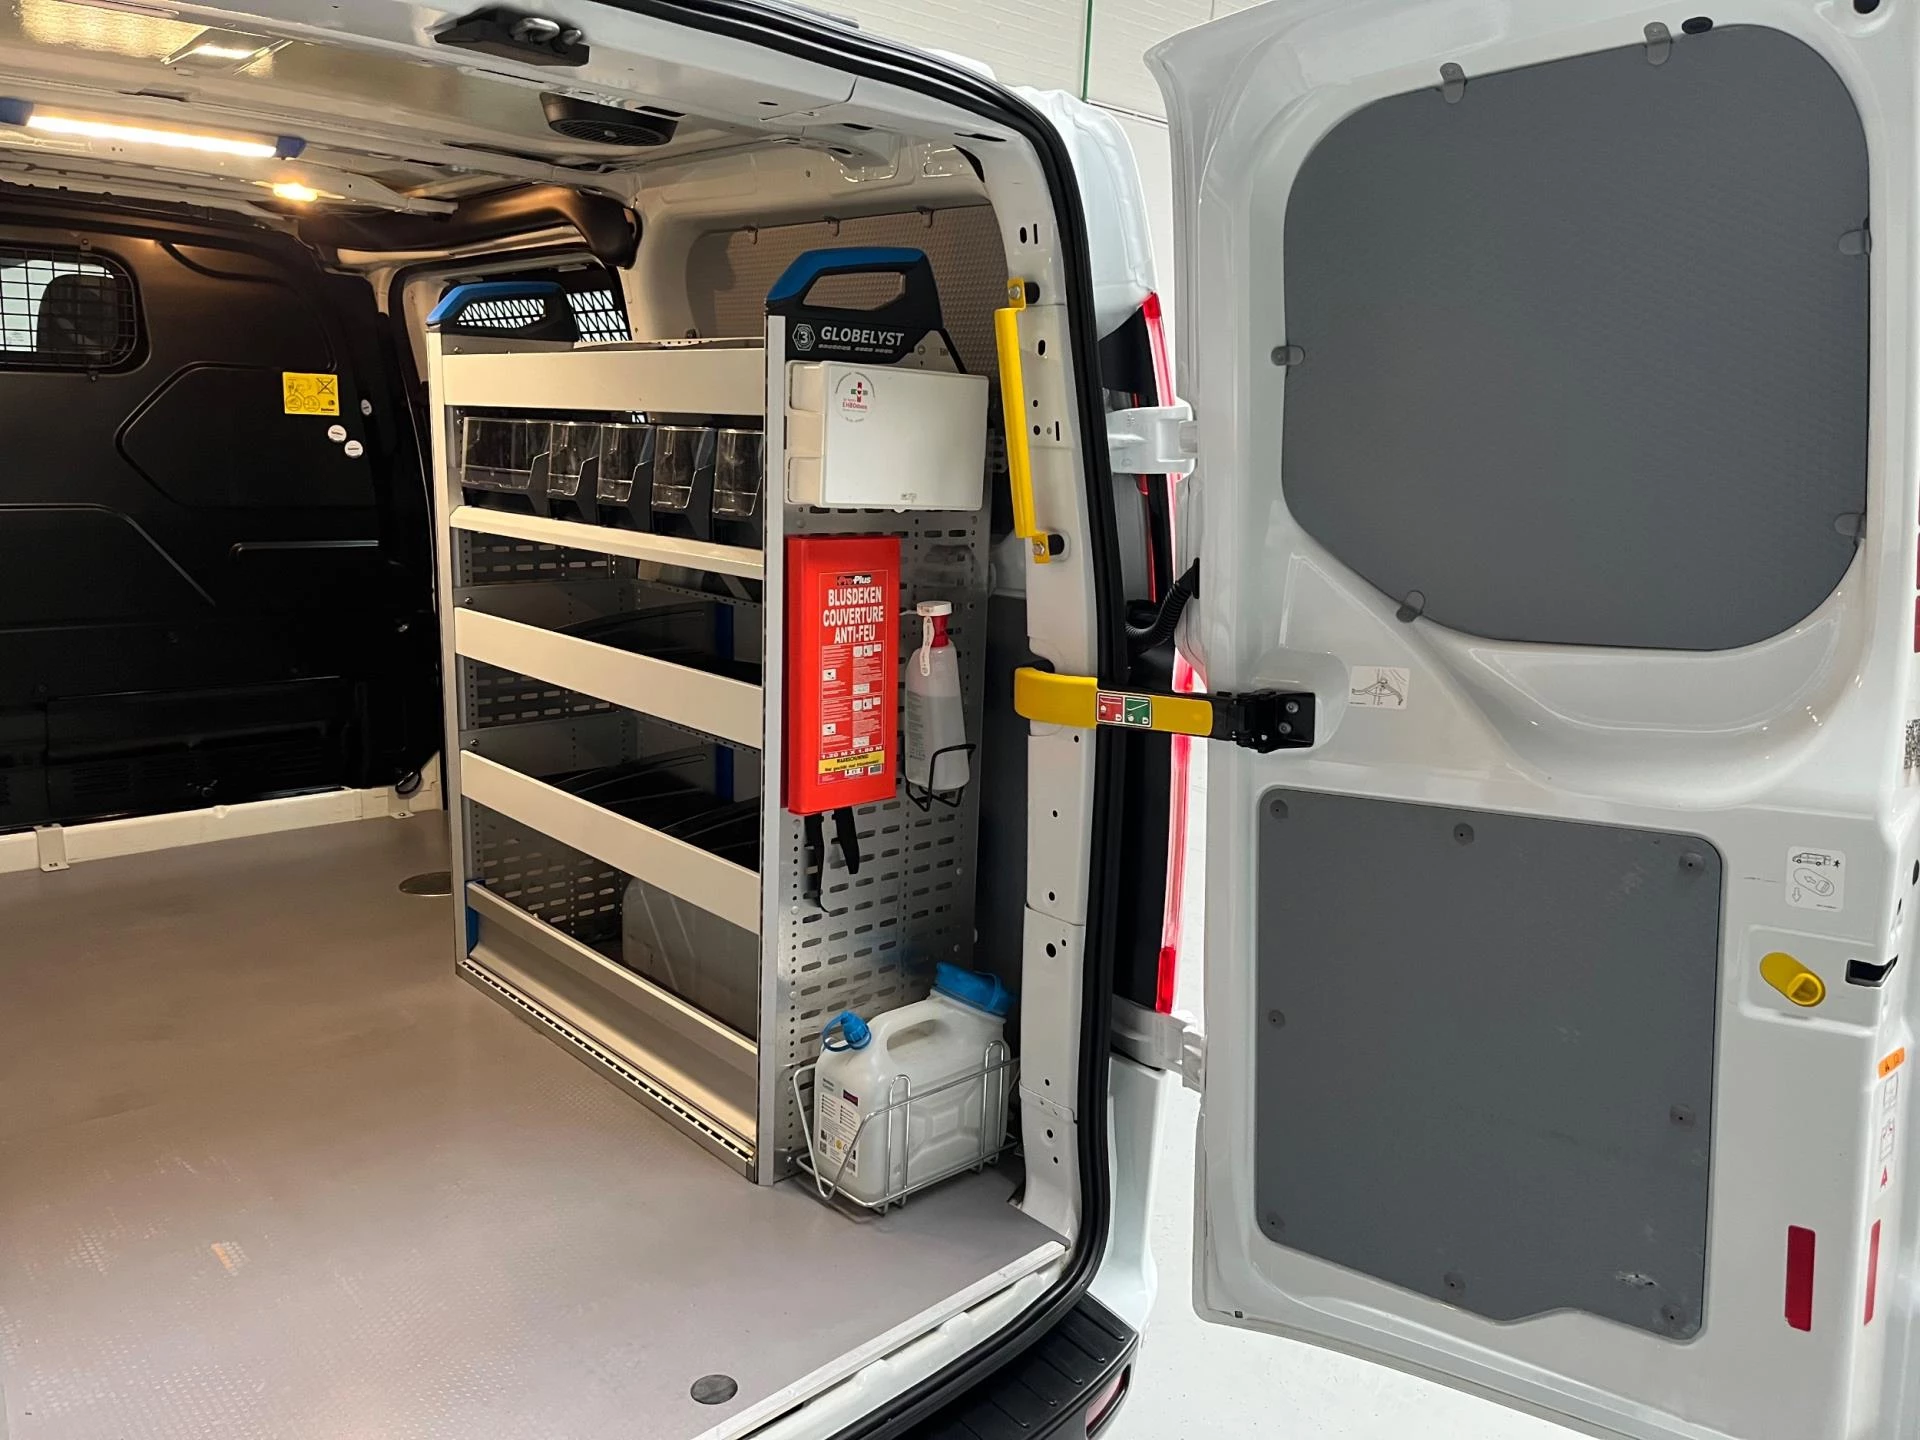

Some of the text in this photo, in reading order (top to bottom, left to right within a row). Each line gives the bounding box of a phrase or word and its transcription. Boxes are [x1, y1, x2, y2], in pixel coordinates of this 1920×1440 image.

[821, 326, 905, 346] GLOBELYST
[828, 586, 882, 607] BLUSDEKEN
[823, 605, 884, 627] COUVERTURE
[834, 624, 876, 644] ANTI-FEU
